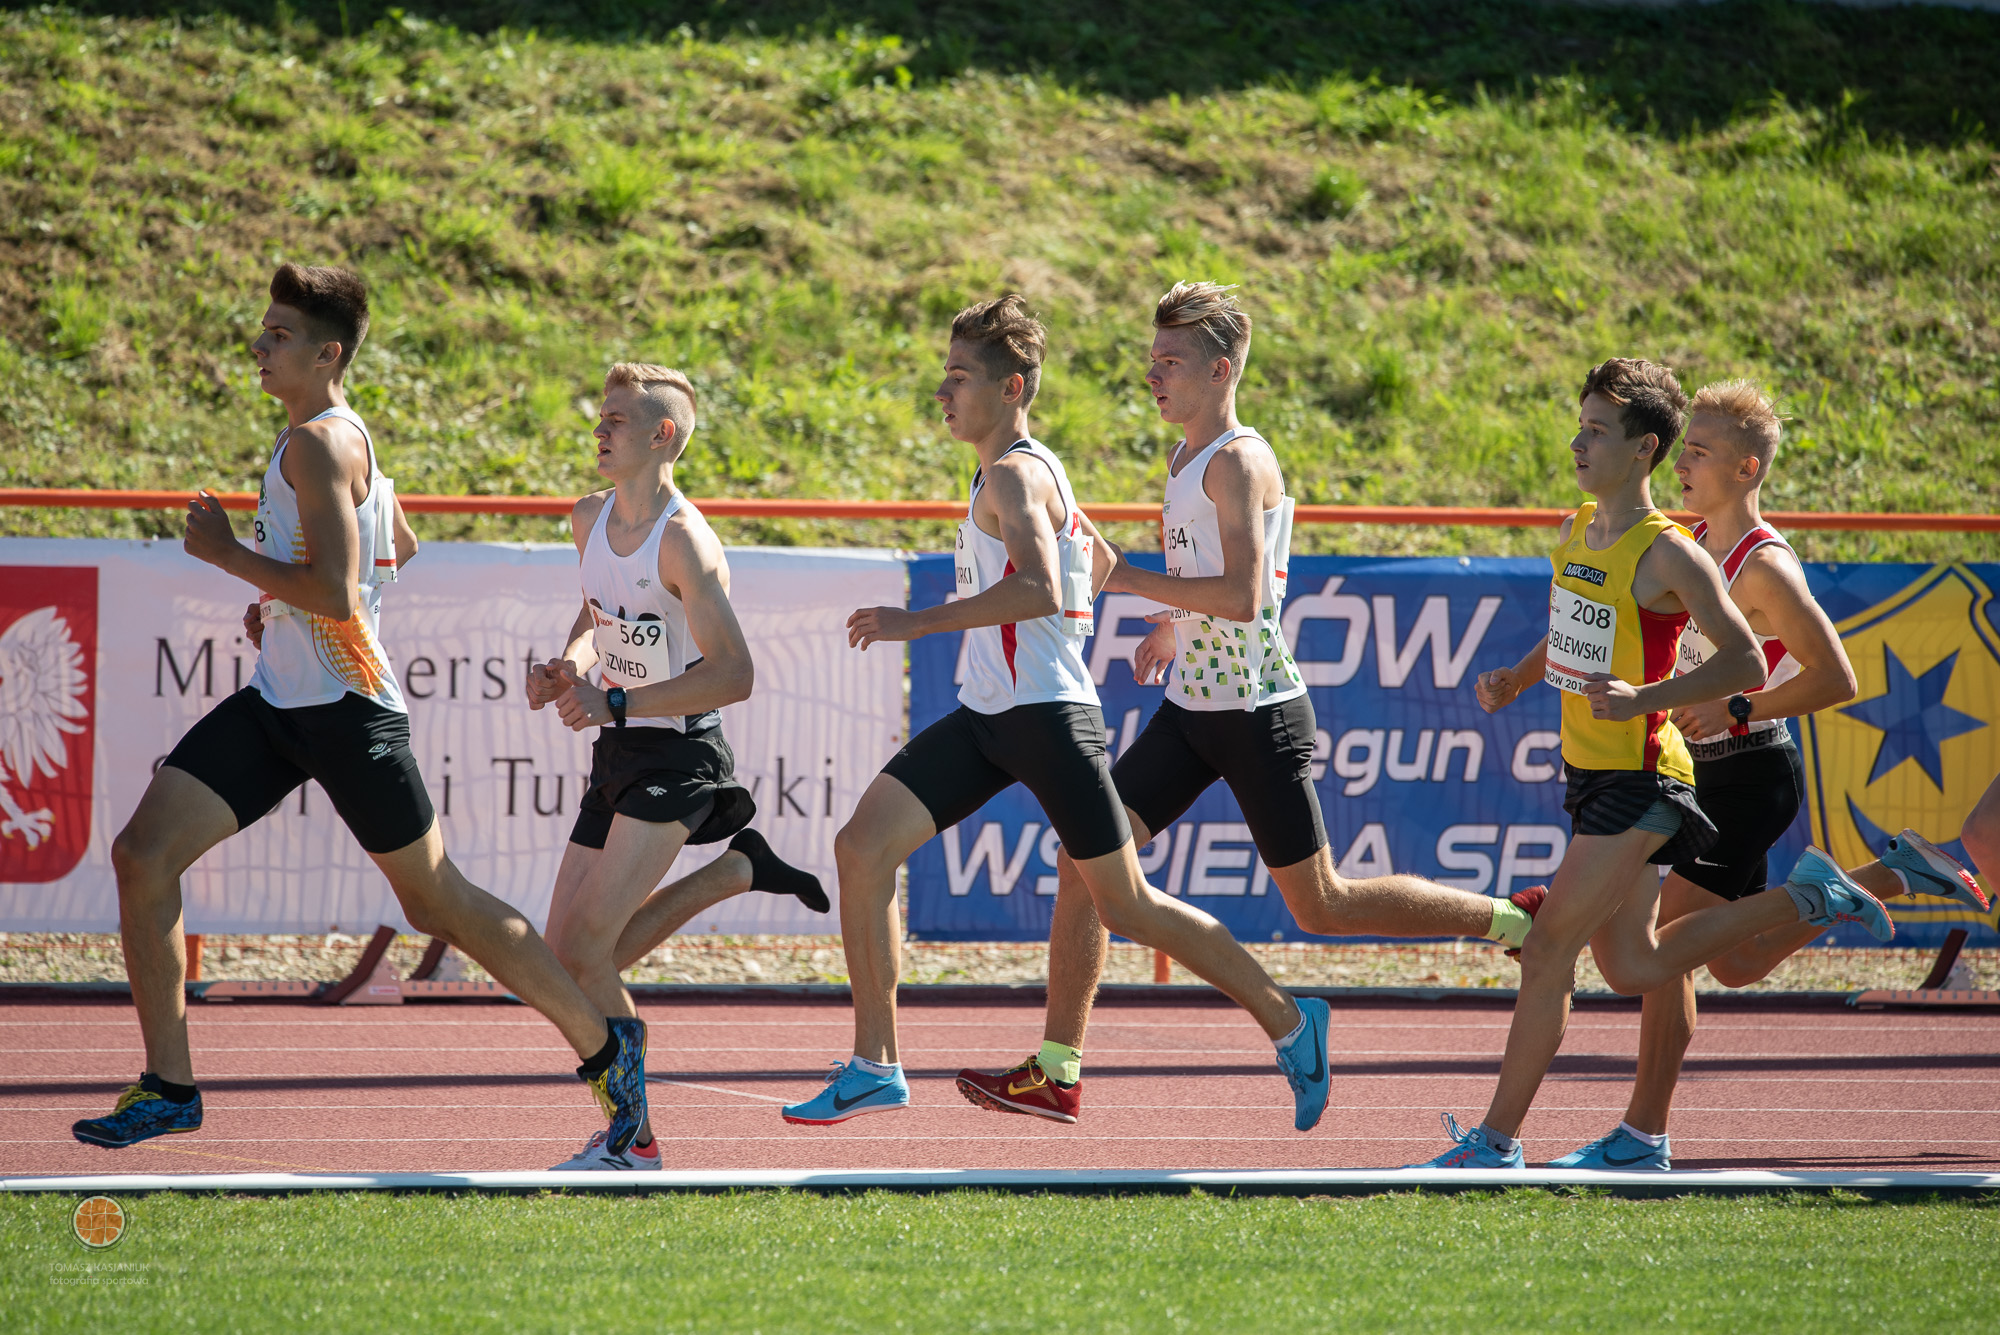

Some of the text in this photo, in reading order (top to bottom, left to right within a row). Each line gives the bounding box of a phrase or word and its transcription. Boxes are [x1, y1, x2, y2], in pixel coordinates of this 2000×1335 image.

[1570, 599, 1611, 629] 208
[619, 623, 661, 647] 569
[1548, 624, 1607, 663] ÓBLEWSKI
[604, 650, 647, 679] SZWED
[1565, 678, 1583, 692] 201
[1702, 737, 1725, 759] PRO
[1727, 728, 1767, 753] NIKE
[645, 785, 668, 798] 4F
